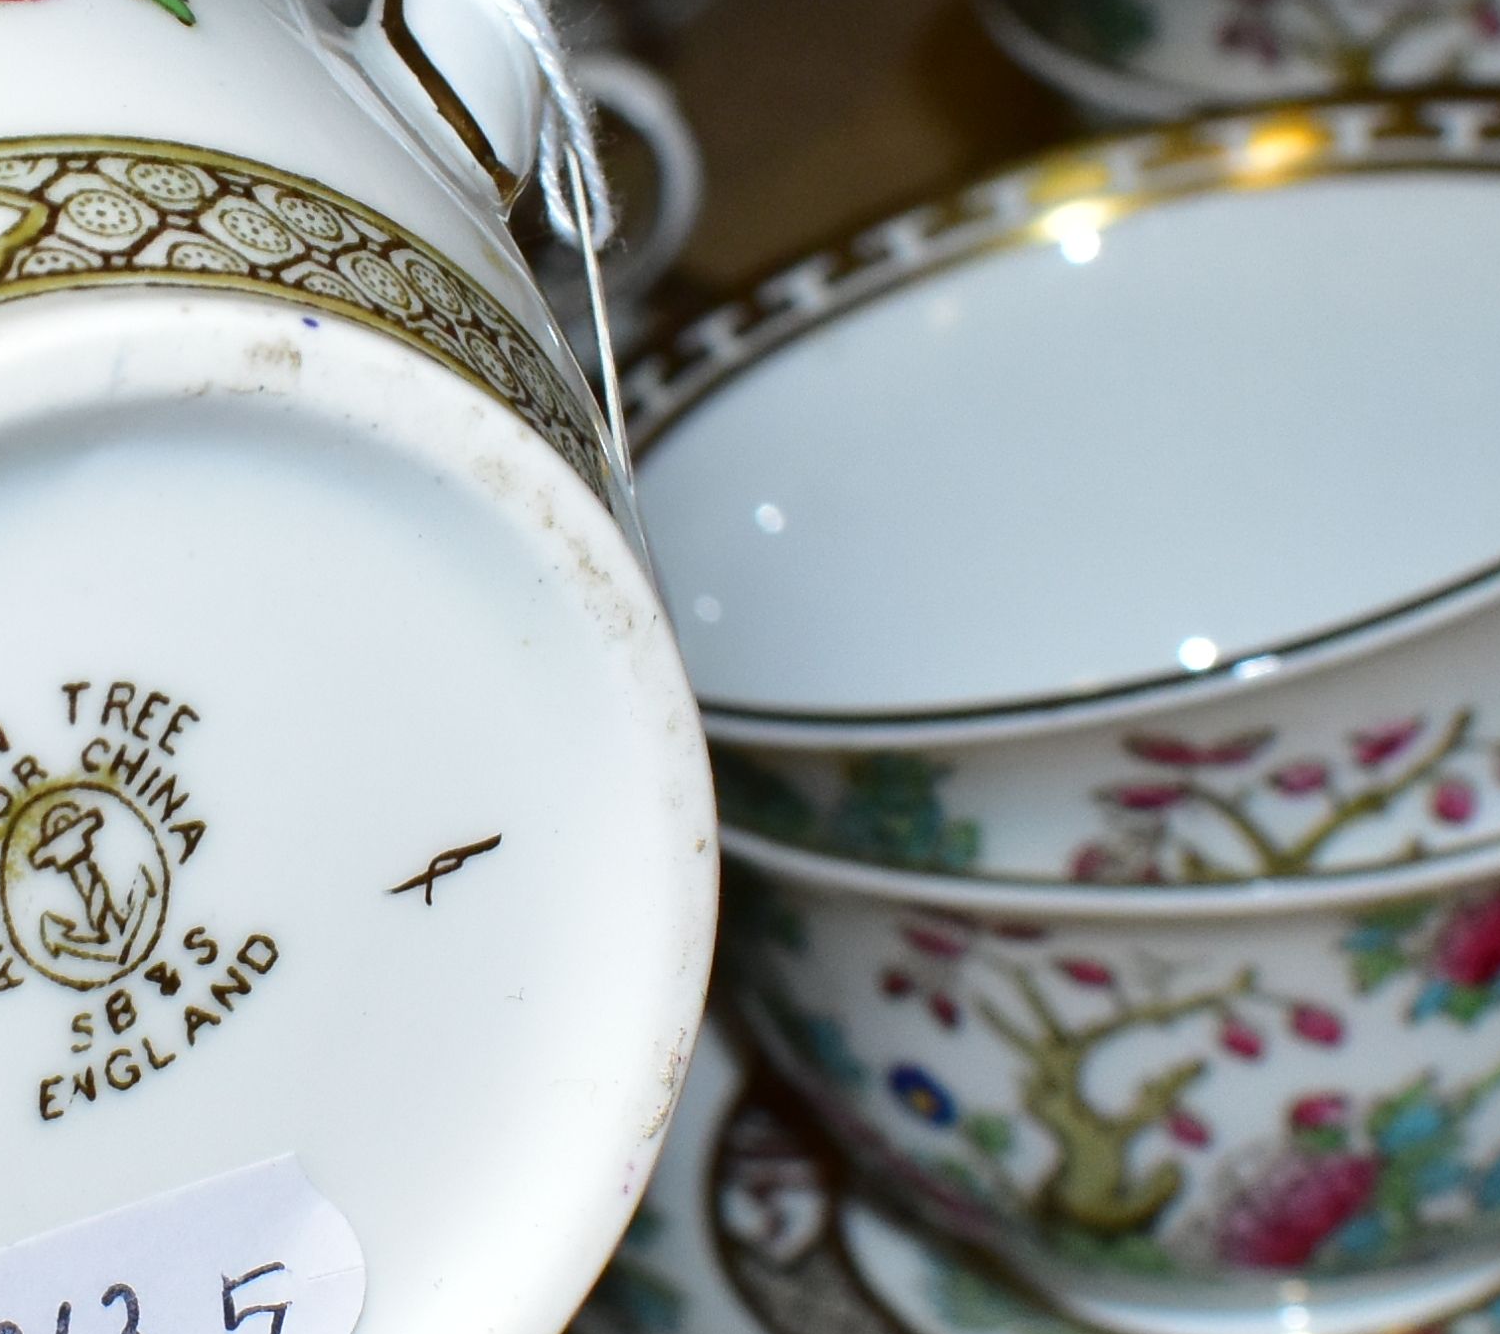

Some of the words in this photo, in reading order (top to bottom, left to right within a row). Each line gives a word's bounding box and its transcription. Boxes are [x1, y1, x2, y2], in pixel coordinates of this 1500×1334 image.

[60, 680, 201, 757] TREE
[81, 736, 208, 865] CHINA
[38, 933, 280, 1122] ENGLAND
